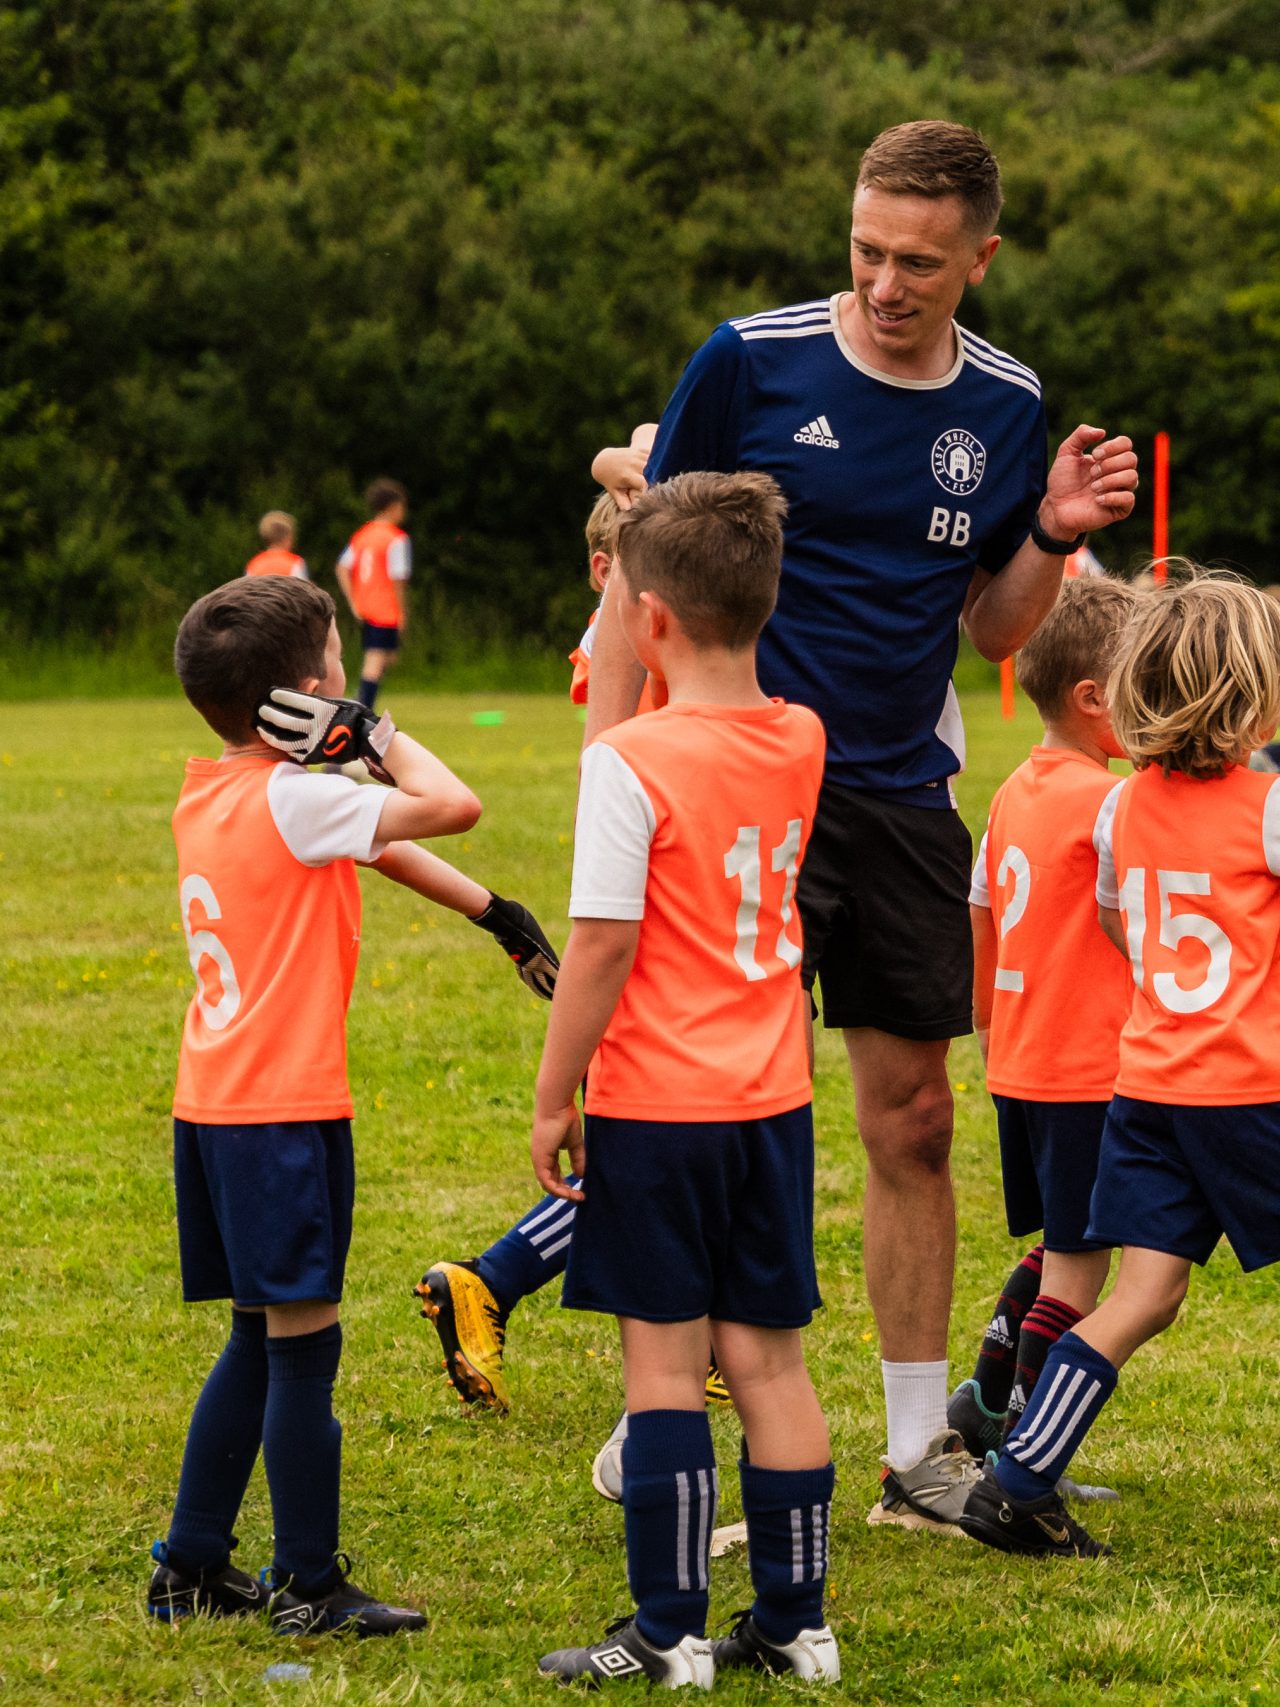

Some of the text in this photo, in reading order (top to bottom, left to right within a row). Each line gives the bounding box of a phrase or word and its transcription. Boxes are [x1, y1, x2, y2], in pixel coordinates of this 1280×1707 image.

[793, 432, 840, 449] adidas
[935, 445, 945, 475] EAST
[944, 432, 975, 449] WHEAL
[952, 482, 965, 493] FC
[926, 506, 971, 547] BB
[724, 818, 803, 982] 11
[180, 873, 241, 1031] 6
[1119, 867, 1233, 1014] 15
